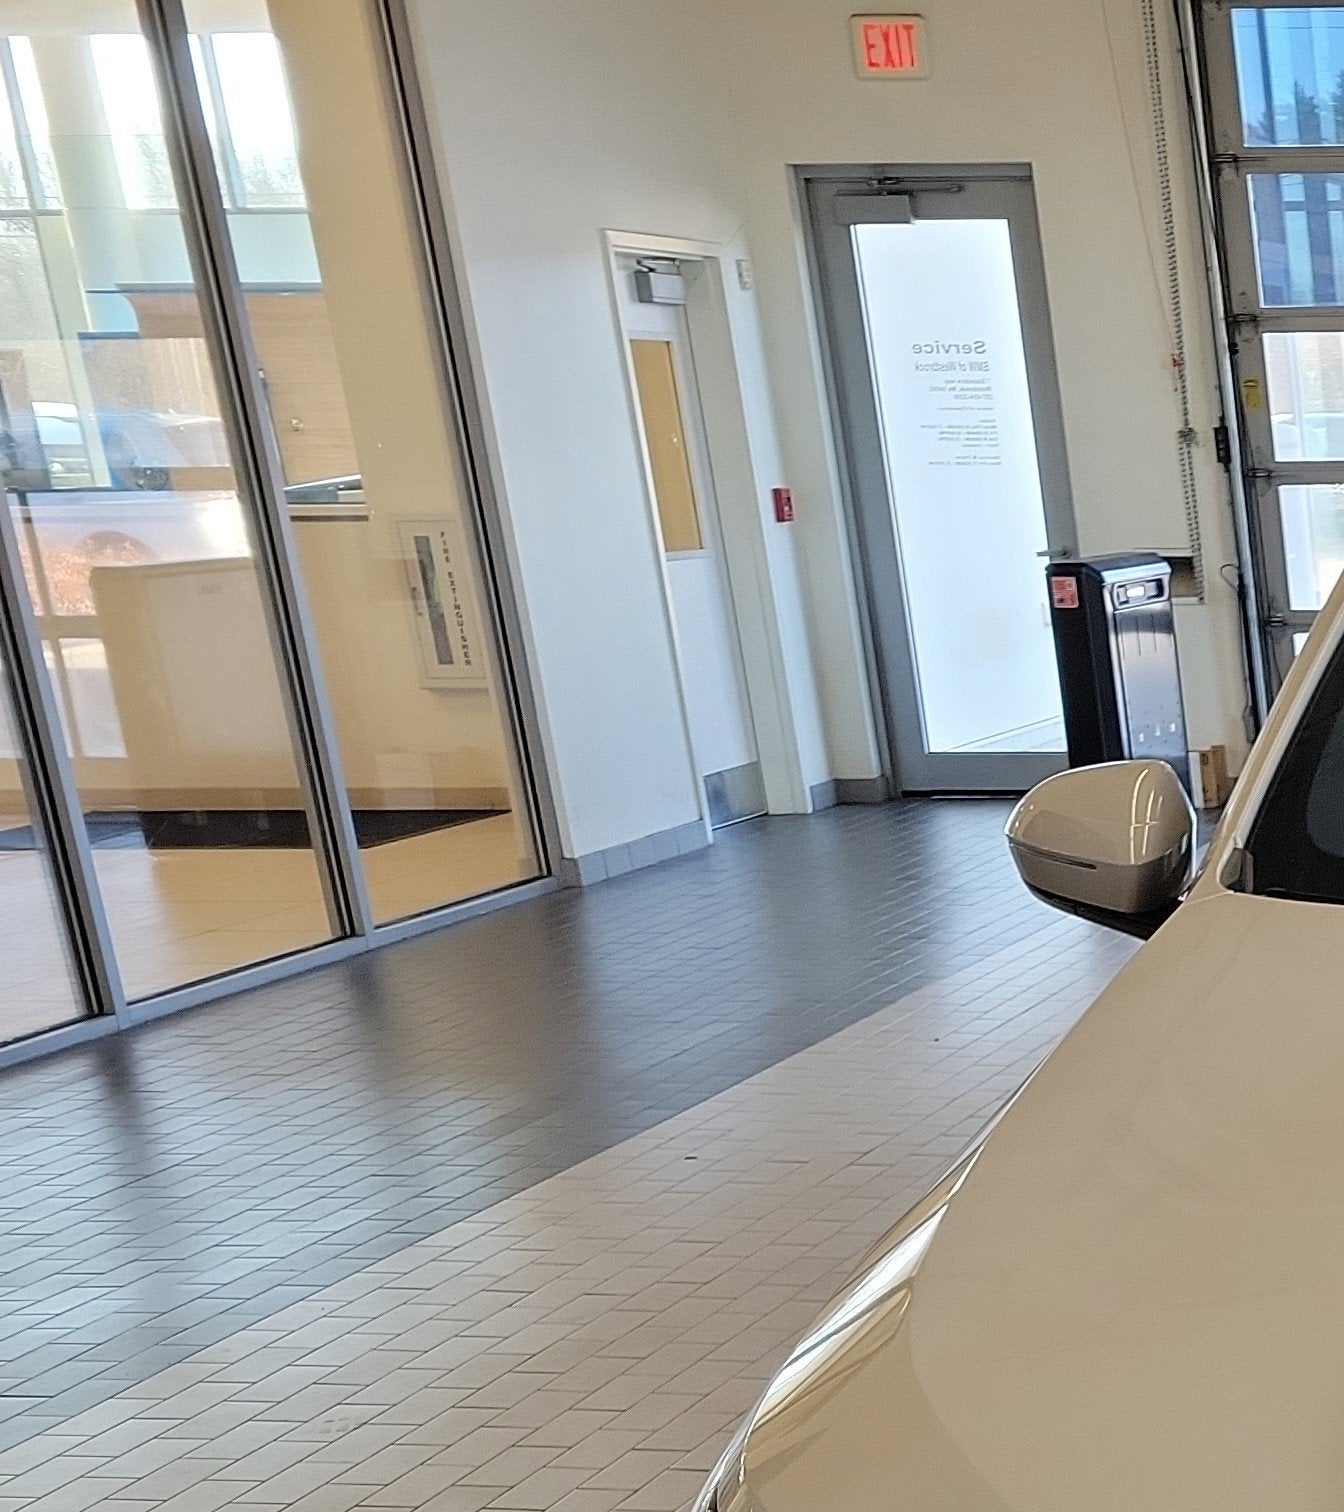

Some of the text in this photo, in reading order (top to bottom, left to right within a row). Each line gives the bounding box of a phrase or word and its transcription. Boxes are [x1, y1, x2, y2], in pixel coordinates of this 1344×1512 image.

[863, 24, 914, 67] EXIT
[440, 531, 472, 666] FIRE EXTINGUISHER
